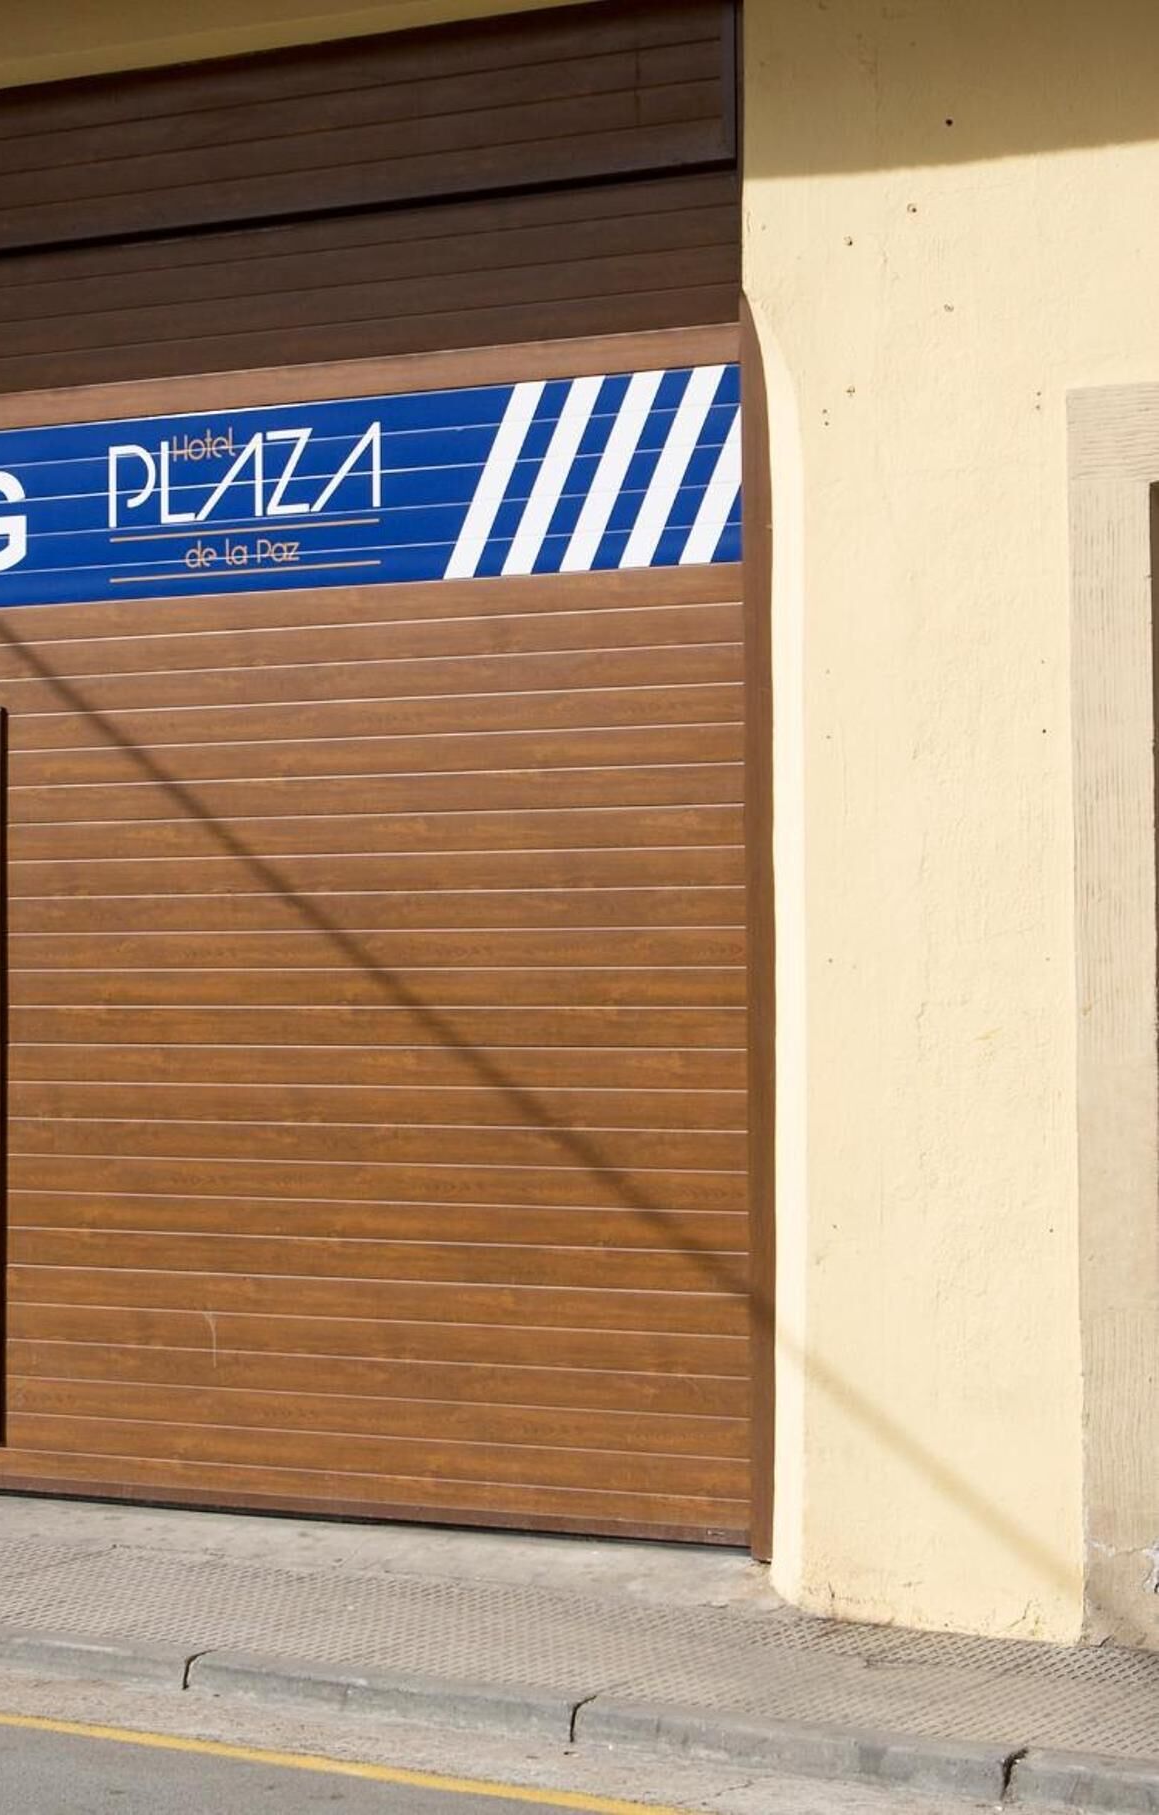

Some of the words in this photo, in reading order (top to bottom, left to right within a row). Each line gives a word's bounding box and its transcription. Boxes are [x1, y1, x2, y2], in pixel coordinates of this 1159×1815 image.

[172, 426, 236, 462] Hotel
[107, 421, 382, 528] PLAZA
[185, 540, 218, 568] de
[225, 538, 248, 566] la
[256, 538, 301, 563] Paz
